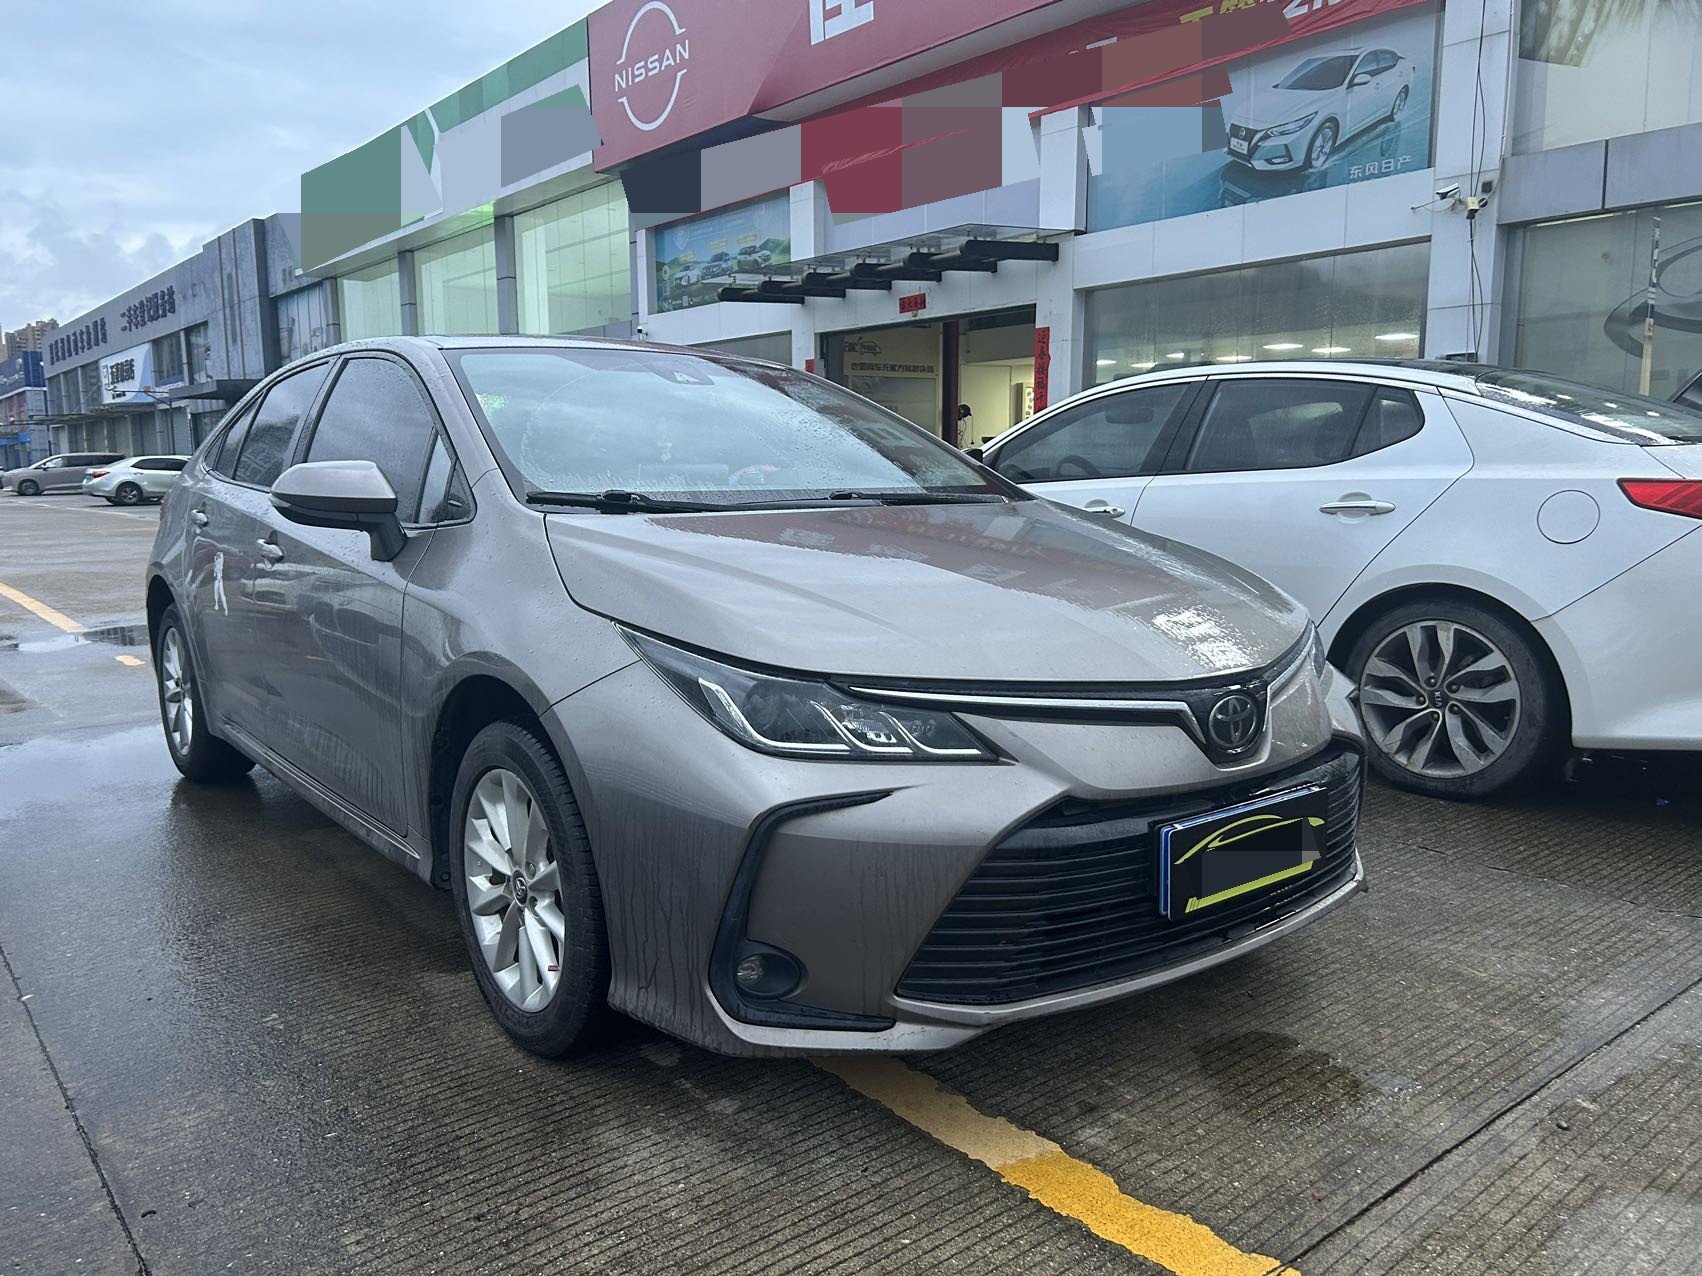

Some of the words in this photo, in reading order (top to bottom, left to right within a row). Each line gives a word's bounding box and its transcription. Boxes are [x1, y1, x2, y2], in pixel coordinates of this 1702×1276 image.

[615, 40, 689, 92] NISSAN
[1350, 155, 1411, 179] 东风日产
[1434, 691, 1443, 708] KIA
